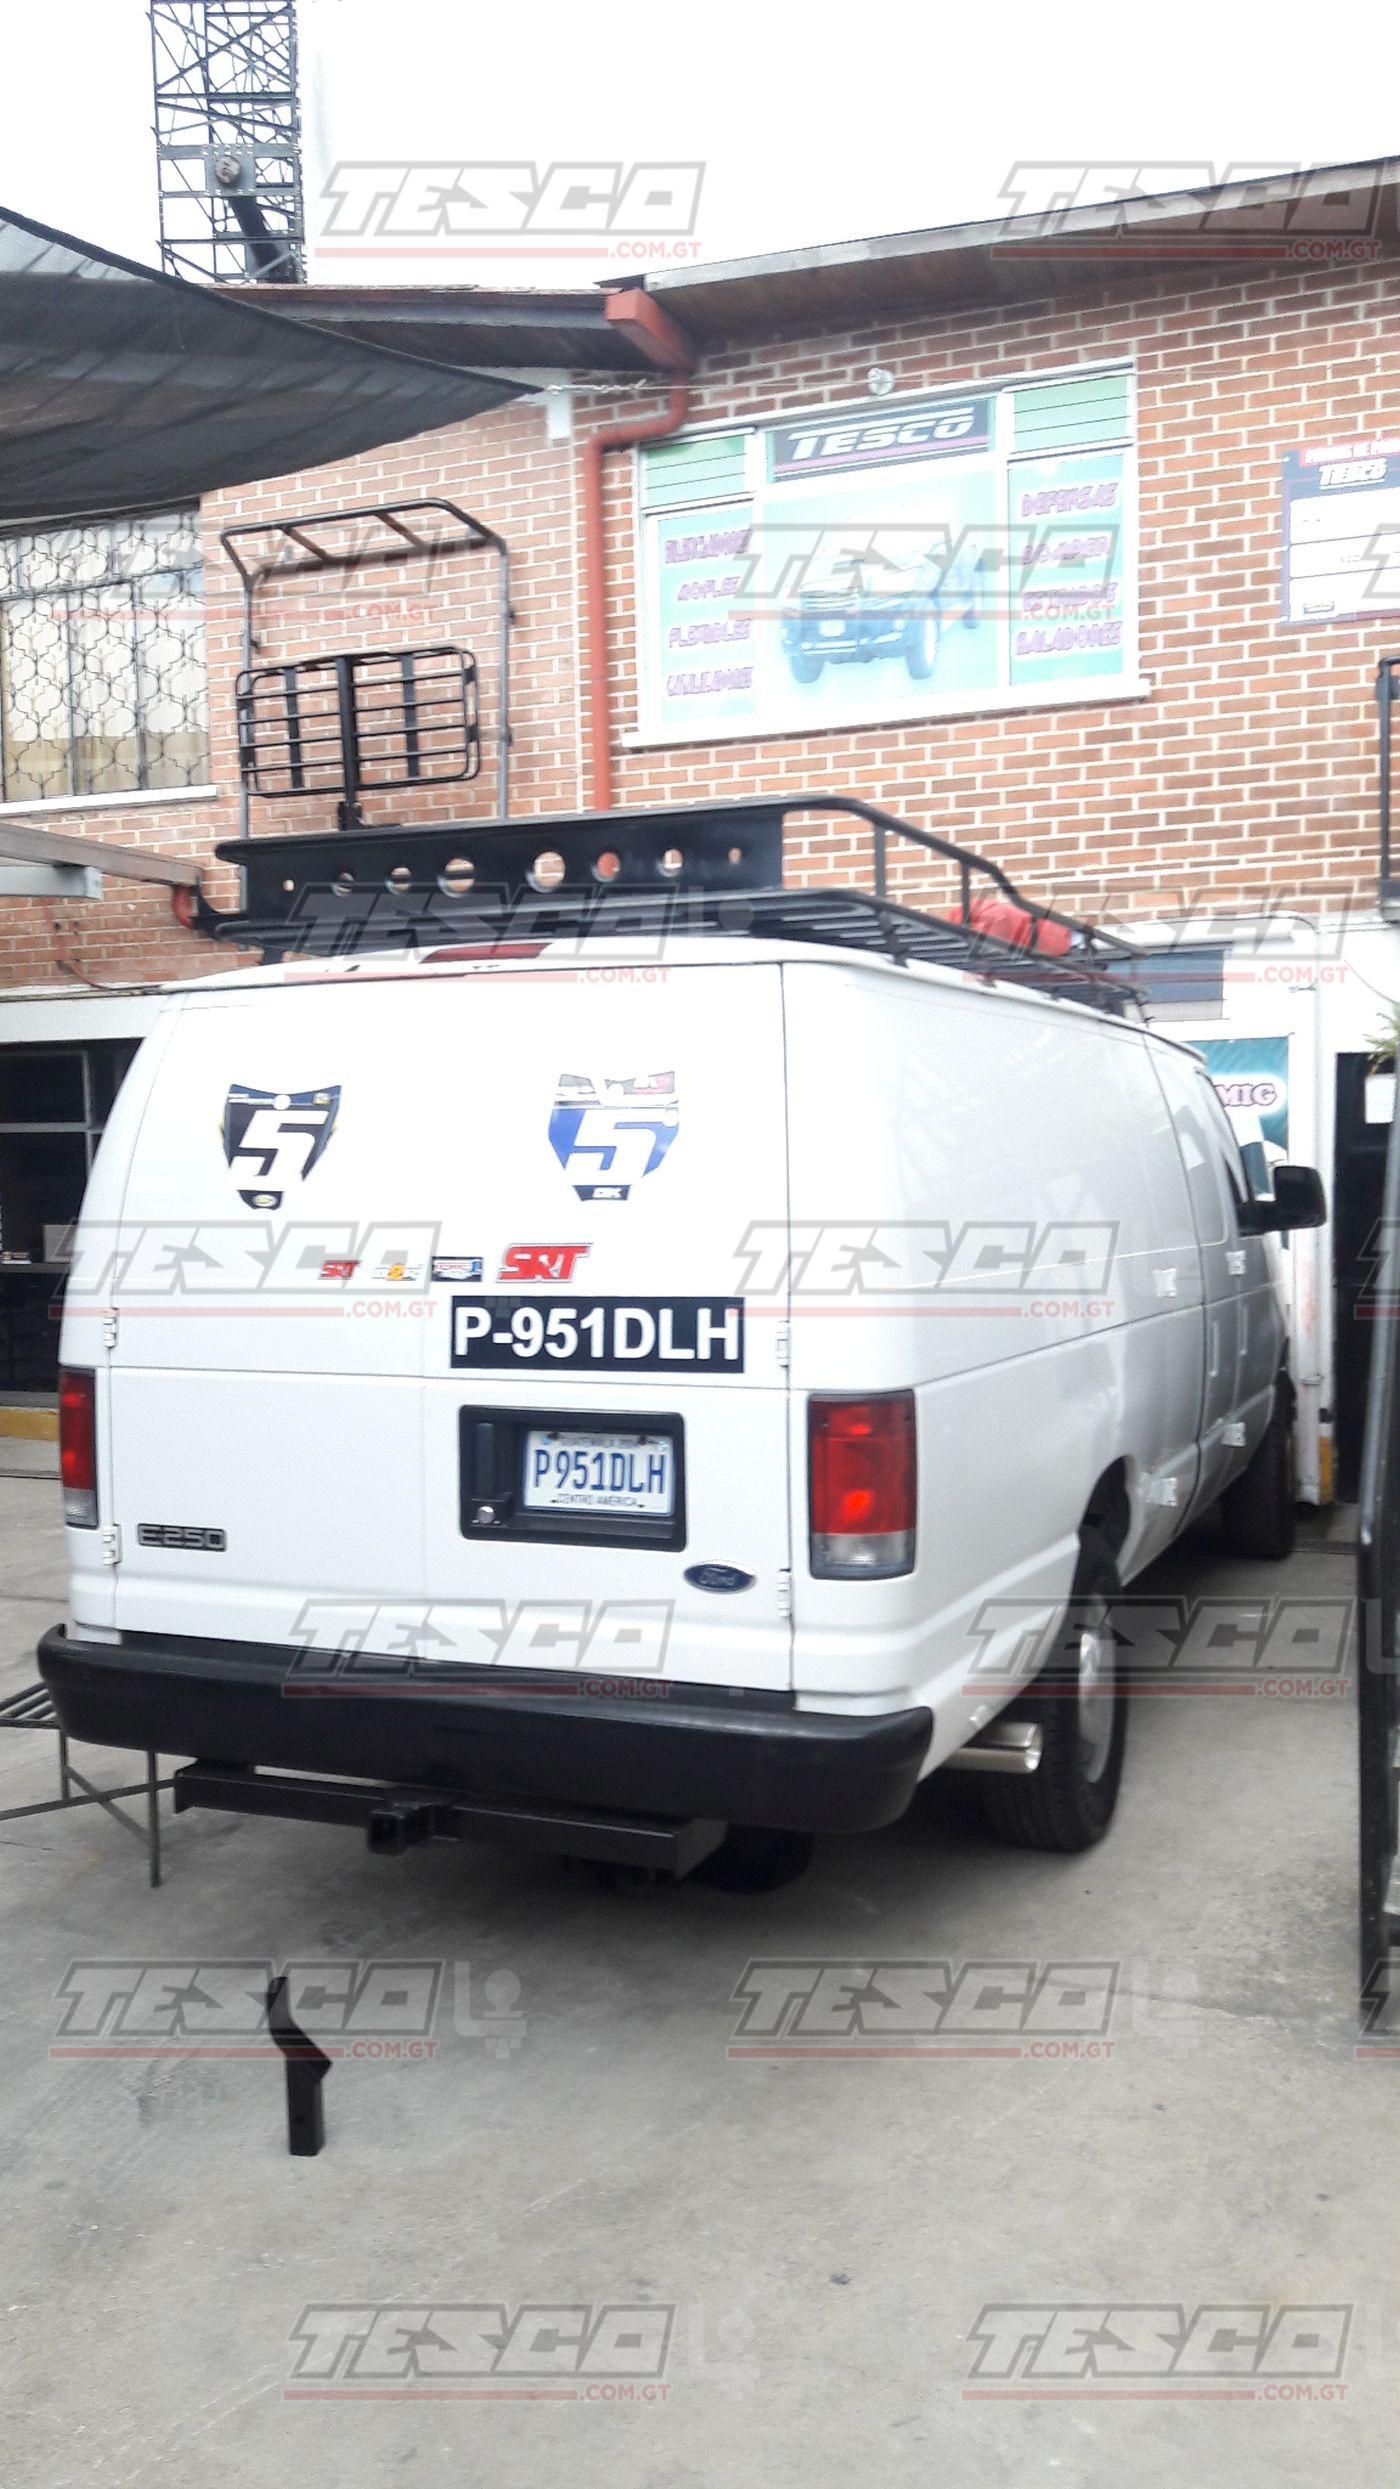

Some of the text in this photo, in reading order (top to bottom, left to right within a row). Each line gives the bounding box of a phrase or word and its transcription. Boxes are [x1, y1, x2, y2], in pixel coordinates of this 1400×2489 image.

[787, 407, 975, 460] TESCO
[229, 1110, 329, 1188] 5
[565, 1109, 662, 1186] 5
[496, 1243, 594, 1283] SRT
[455, 1306, 739, 1360] P-951DLH
[534, 1449, 665, 1494] P951DLH
